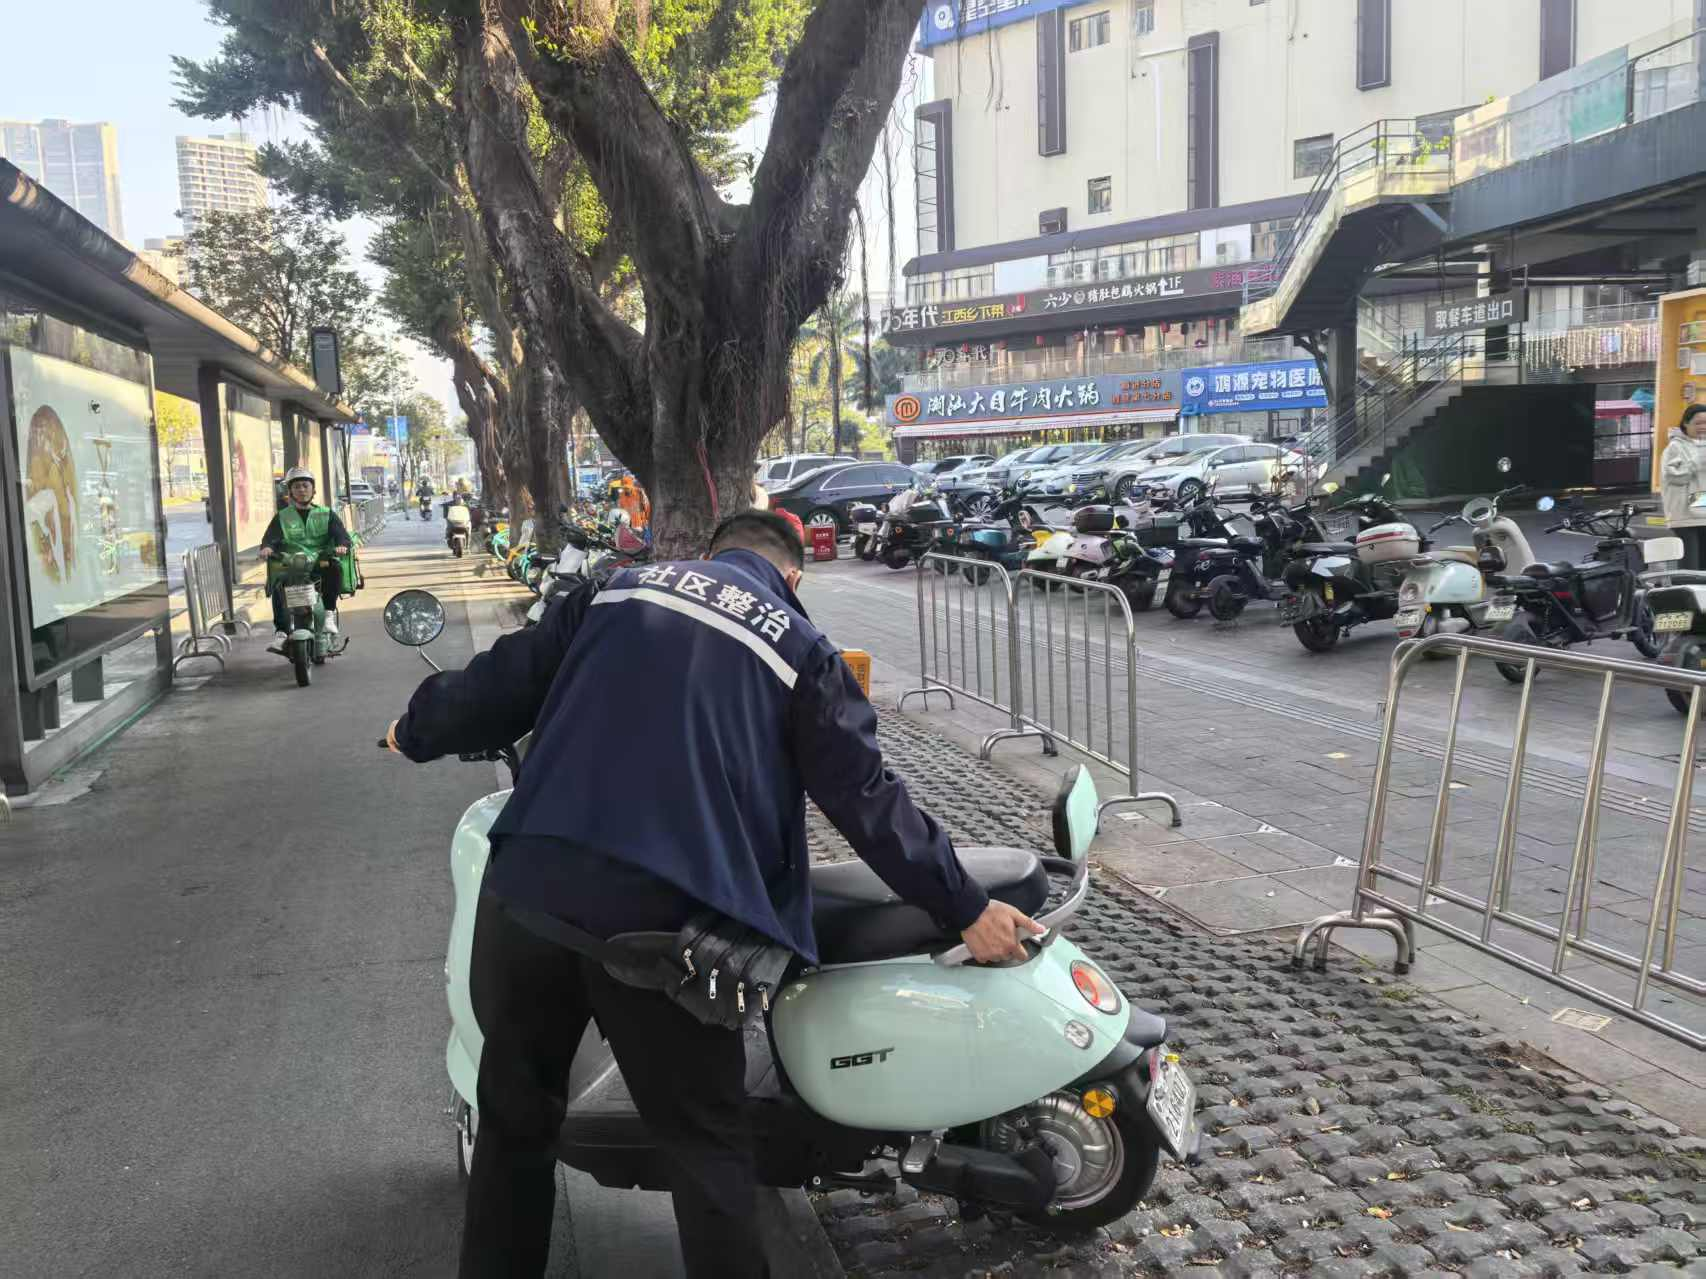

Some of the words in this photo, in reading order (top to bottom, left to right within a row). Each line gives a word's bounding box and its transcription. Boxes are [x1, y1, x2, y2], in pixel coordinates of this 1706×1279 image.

[1168, 276, 1182, 289] 1F
[1435, 300, 1513, 330] 取餐车道出口
[638, 565, 790, 643] 社区整治
[830, 1046, 895, 1070] GGT
